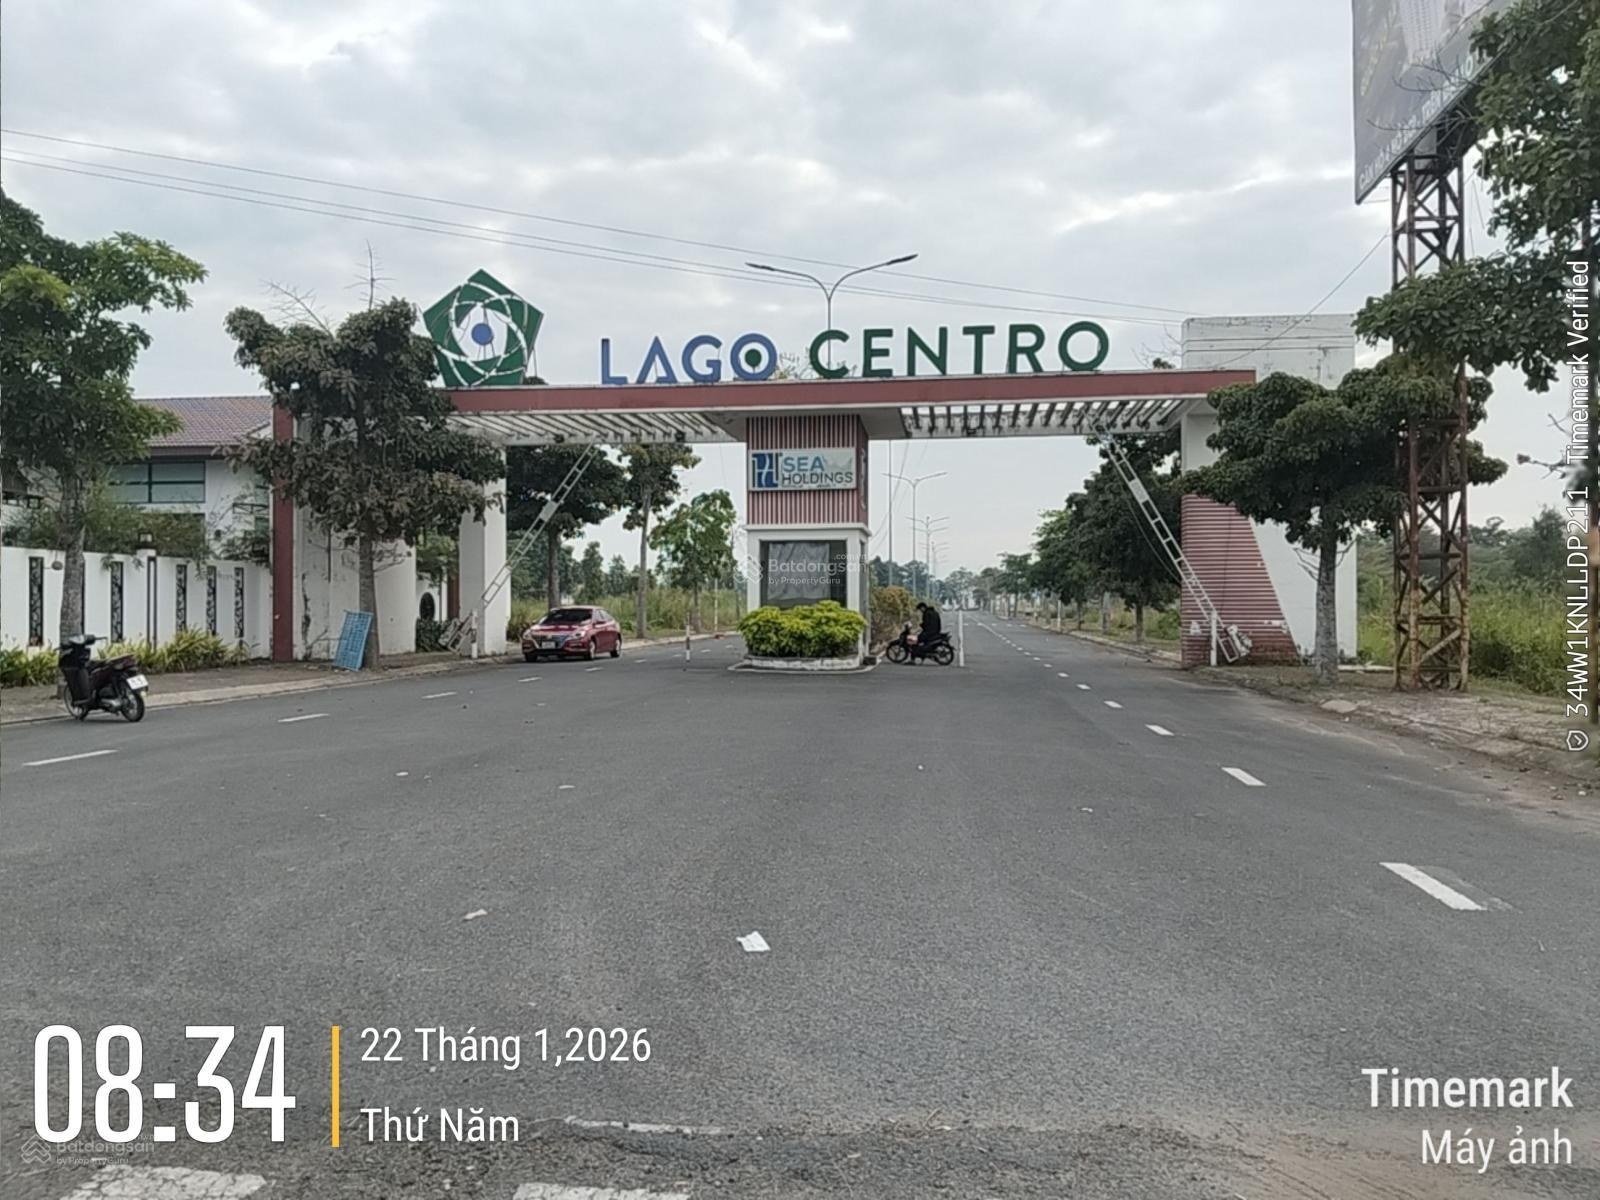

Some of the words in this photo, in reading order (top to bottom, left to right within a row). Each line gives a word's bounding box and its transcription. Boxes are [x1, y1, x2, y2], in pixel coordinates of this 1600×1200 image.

[600, 332, 778, 385] LAGO
[809, 320, 1110, 380] CENTRO
[783, 455, 825, 472] SEA
[781, 471, 854, 485] HOLDINGS
